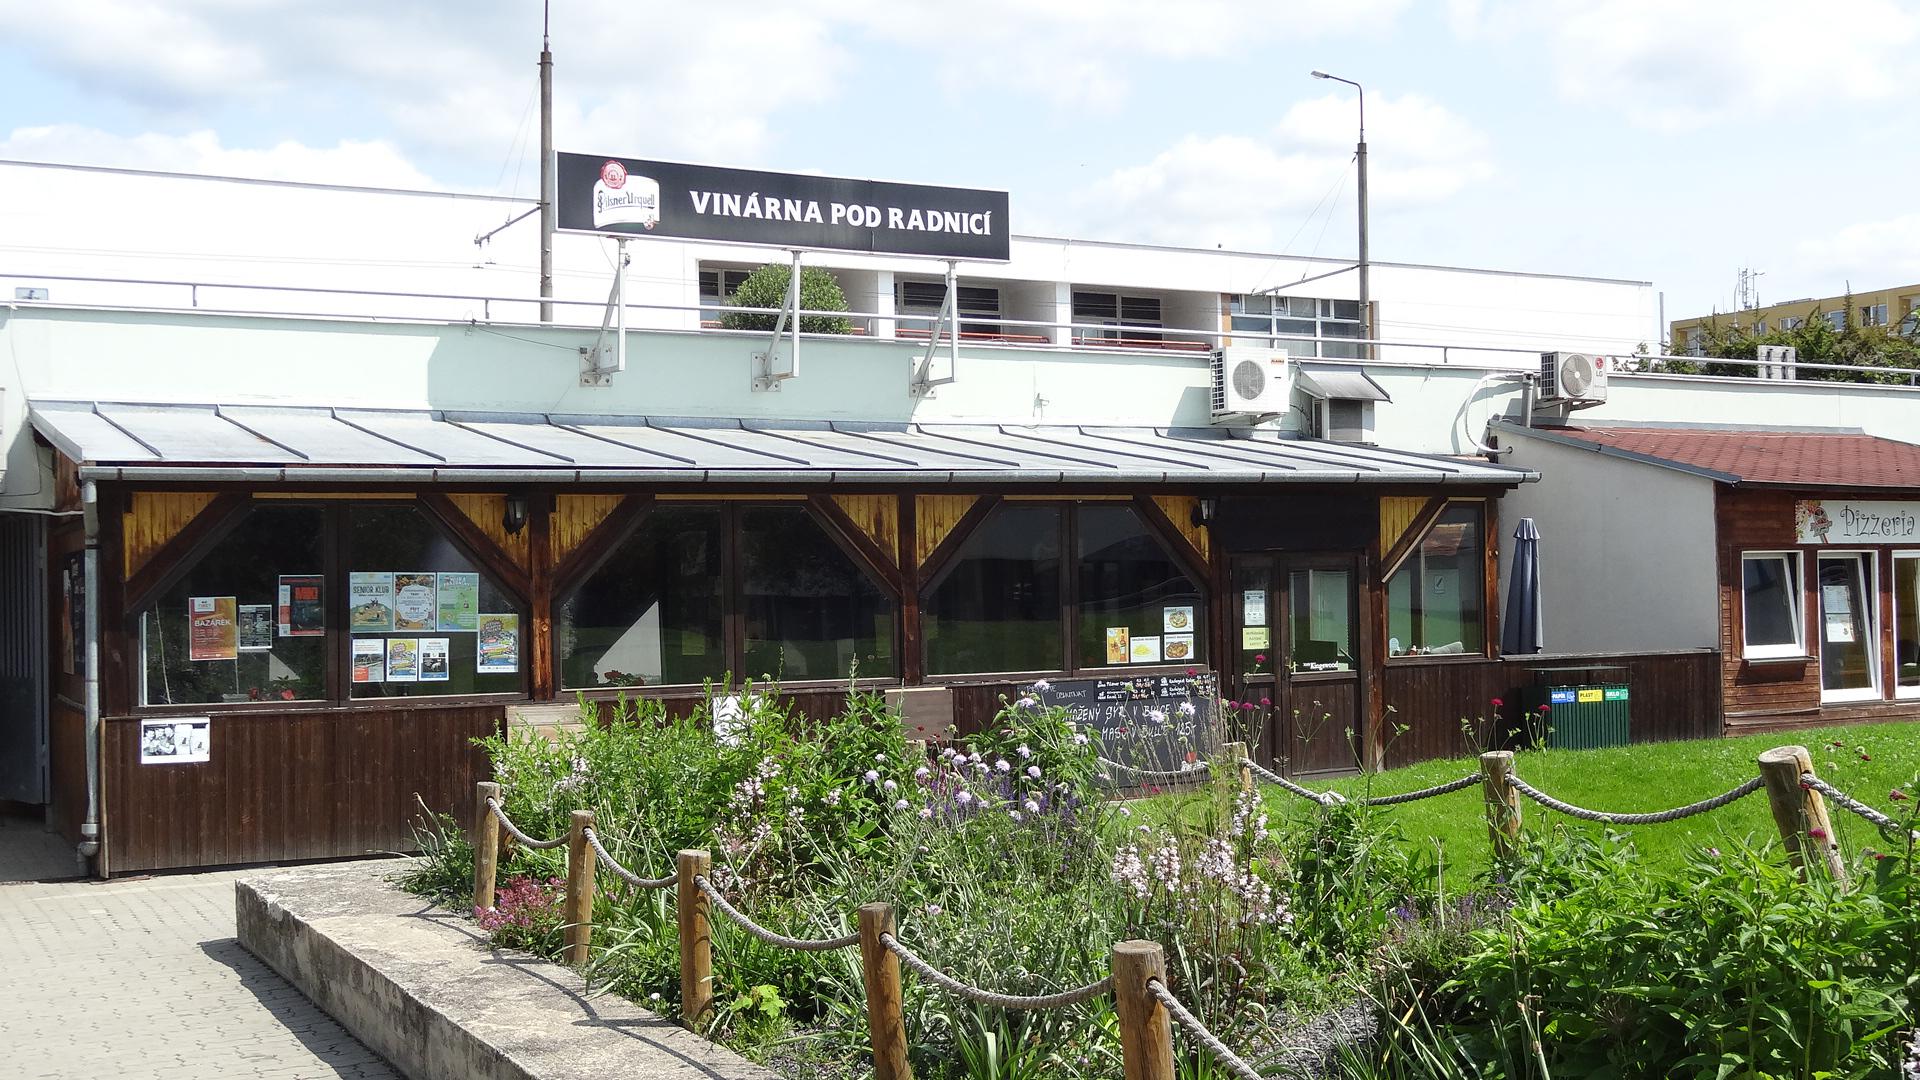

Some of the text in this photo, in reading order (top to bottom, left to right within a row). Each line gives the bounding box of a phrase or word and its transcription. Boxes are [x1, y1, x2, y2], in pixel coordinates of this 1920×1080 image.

[598, 190, 655, 213] Pilsner Urquell
[689, 190, 992, 236] VINÁRNA POD RADNICÍ
[1840, 504, 1915, 537] Pizzeria
[353, 586, 390, 594] SENIOR KLUB
[1063, 703, 1101, 721] MAŽENÝ
